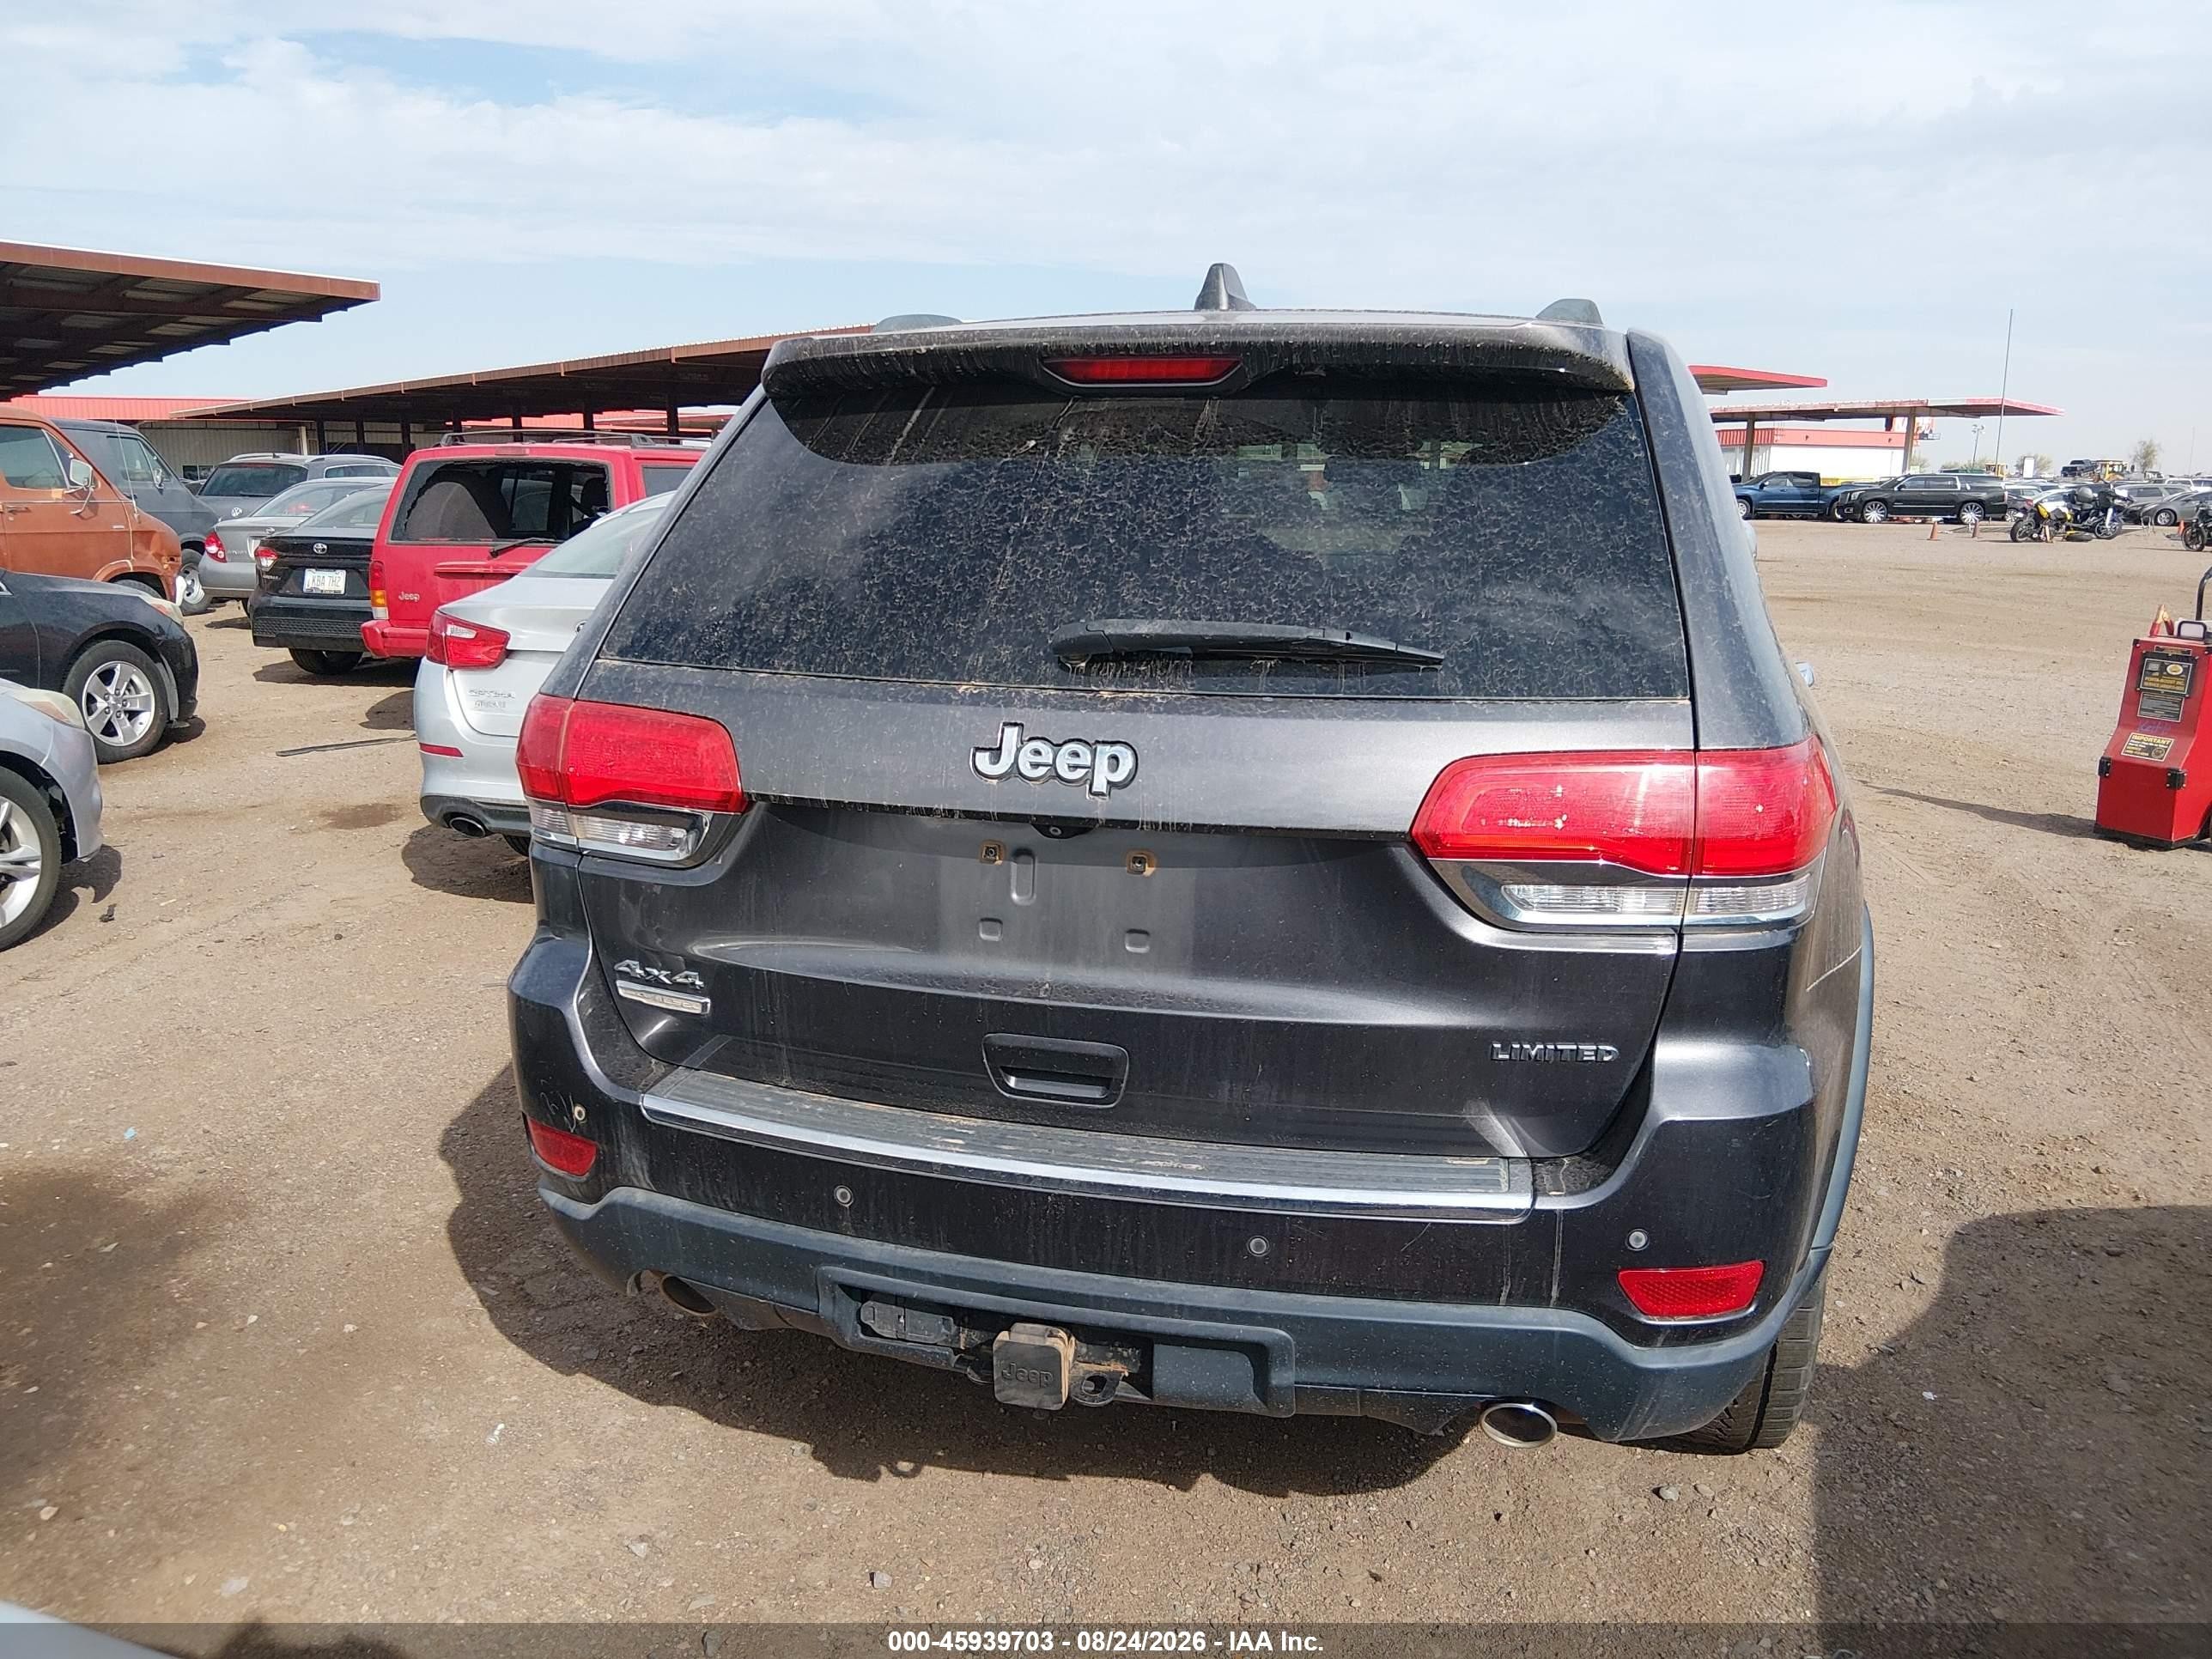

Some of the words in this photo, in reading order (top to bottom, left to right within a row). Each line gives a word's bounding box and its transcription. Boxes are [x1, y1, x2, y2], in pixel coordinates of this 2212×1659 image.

[398, 591, 421, 603] Jeep
[2131, 734, 2172, 746] IMPORTANT
[970, 722, 1138, 799] Jeep
[1491, 1042, 1620, 1063] LIMITED
[1001, 1362, 1054, 1389] Jeep
